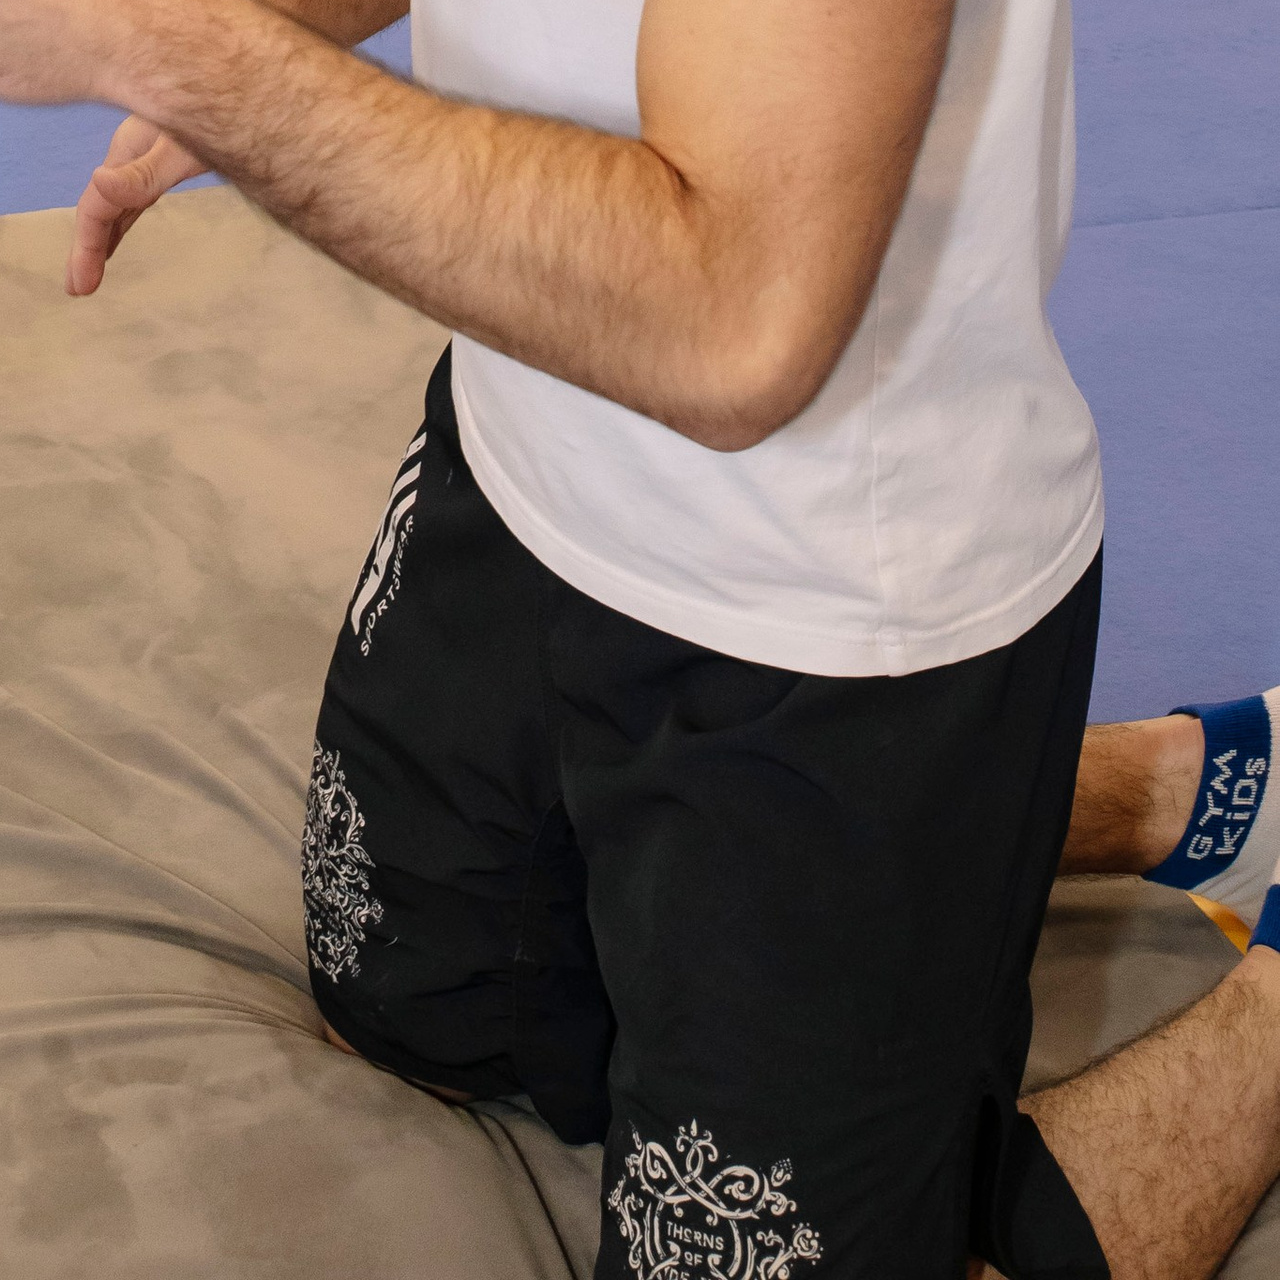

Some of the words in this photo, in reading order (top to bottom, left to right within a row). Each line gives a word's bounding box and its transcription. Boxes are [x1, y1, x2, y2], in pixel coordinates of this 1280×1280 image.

[360, 514, 414, 657] SPORTSWEAR
[1186, 749, 1237, 860] GYM
[666, 1220, 725, 1251] THORNS
[683, 1251, 704, 1267] OF
